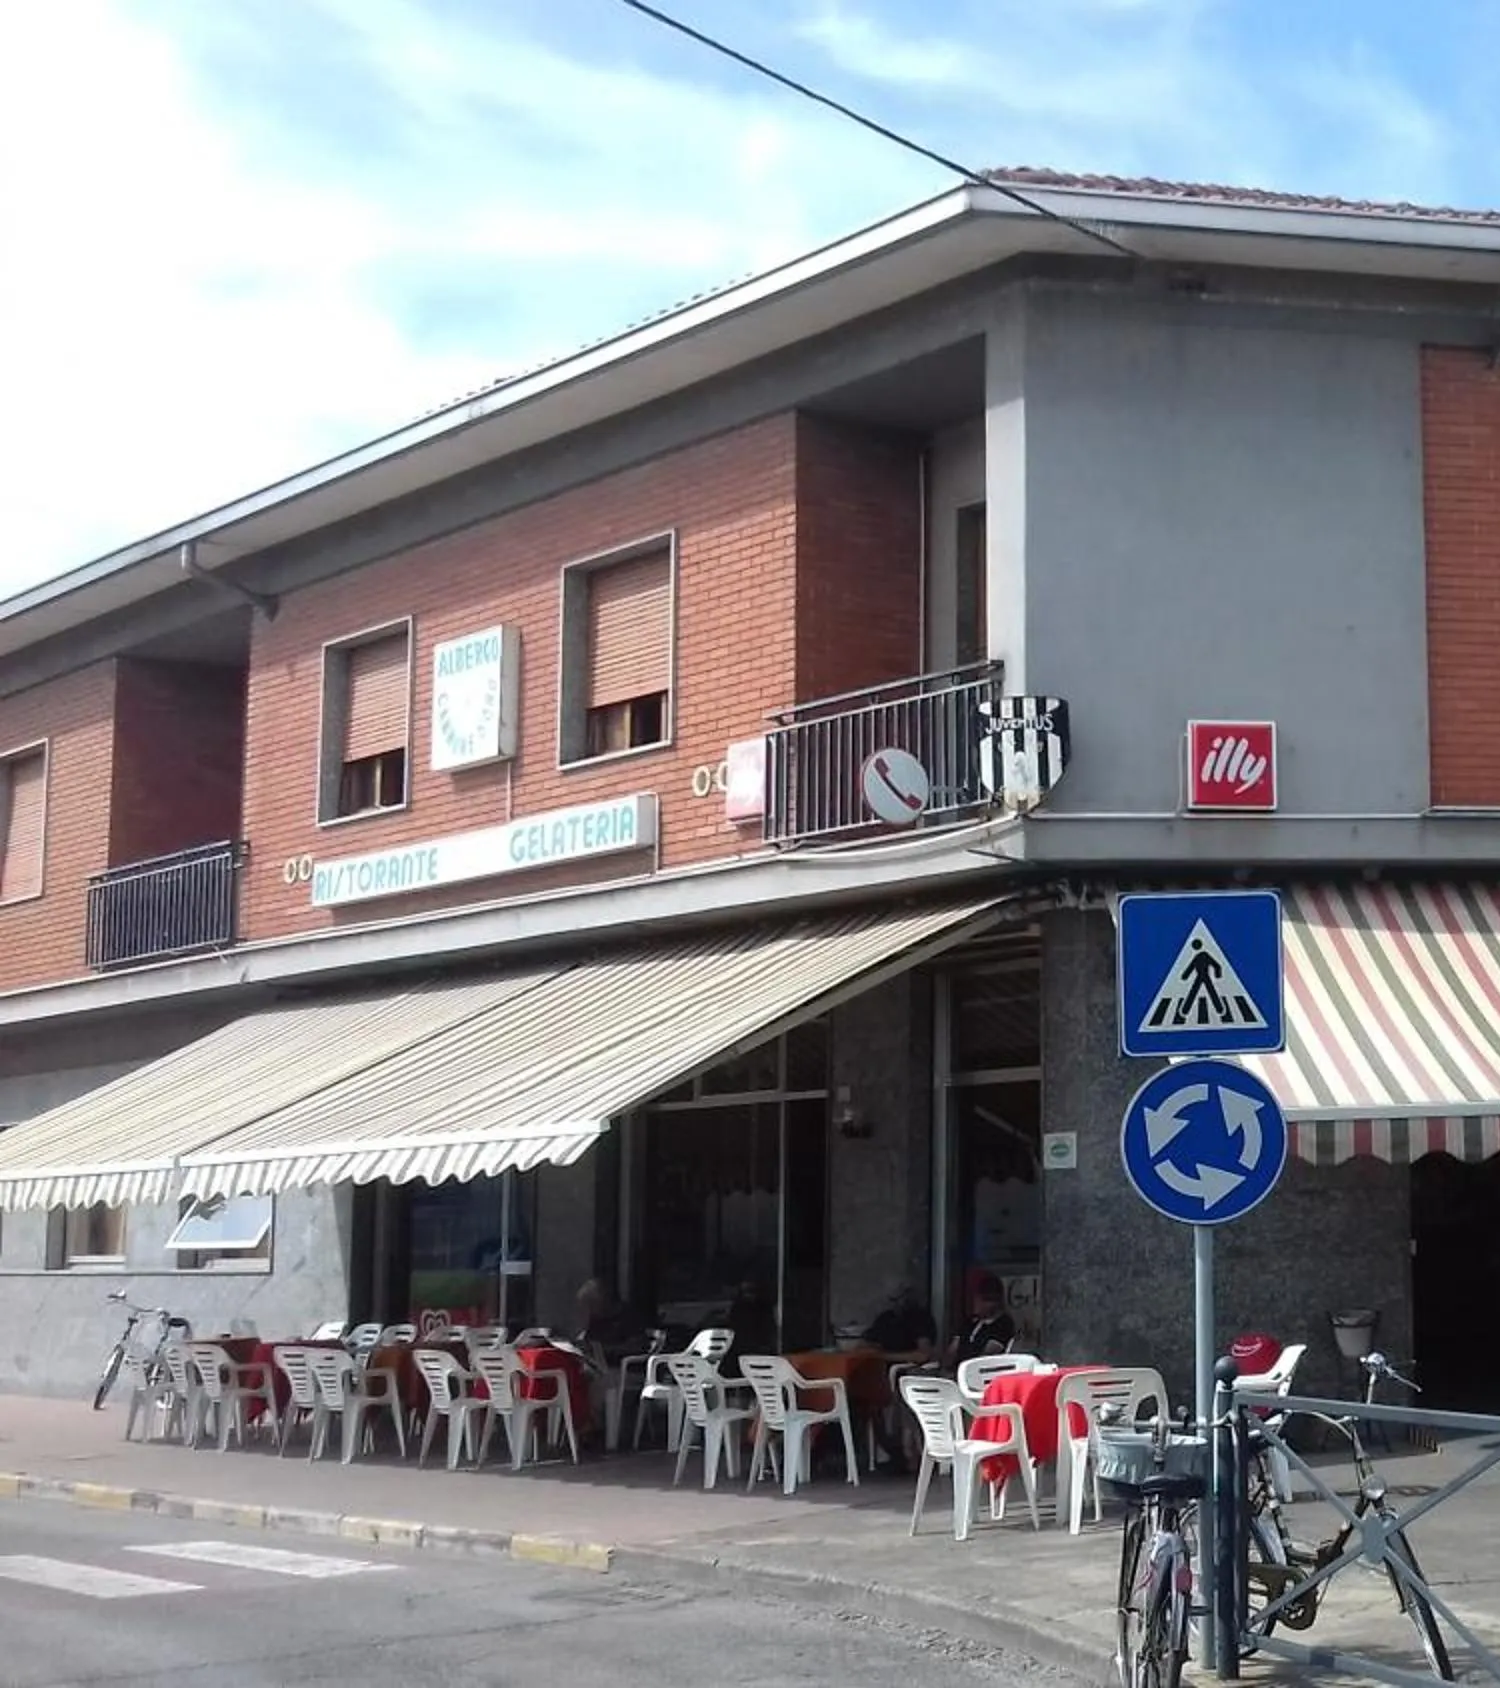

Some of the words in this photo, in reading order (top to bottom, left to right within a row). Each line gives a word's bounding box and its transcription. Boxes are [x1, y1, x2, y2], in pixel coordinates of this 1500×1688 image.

[985, 714, 1055, 735] JUVENTUS
[1200, 735, 1268, 795] illy
[315, 848, 438, 901] RISTORANTE
[510, 805, 634, 862] GELATERIA
